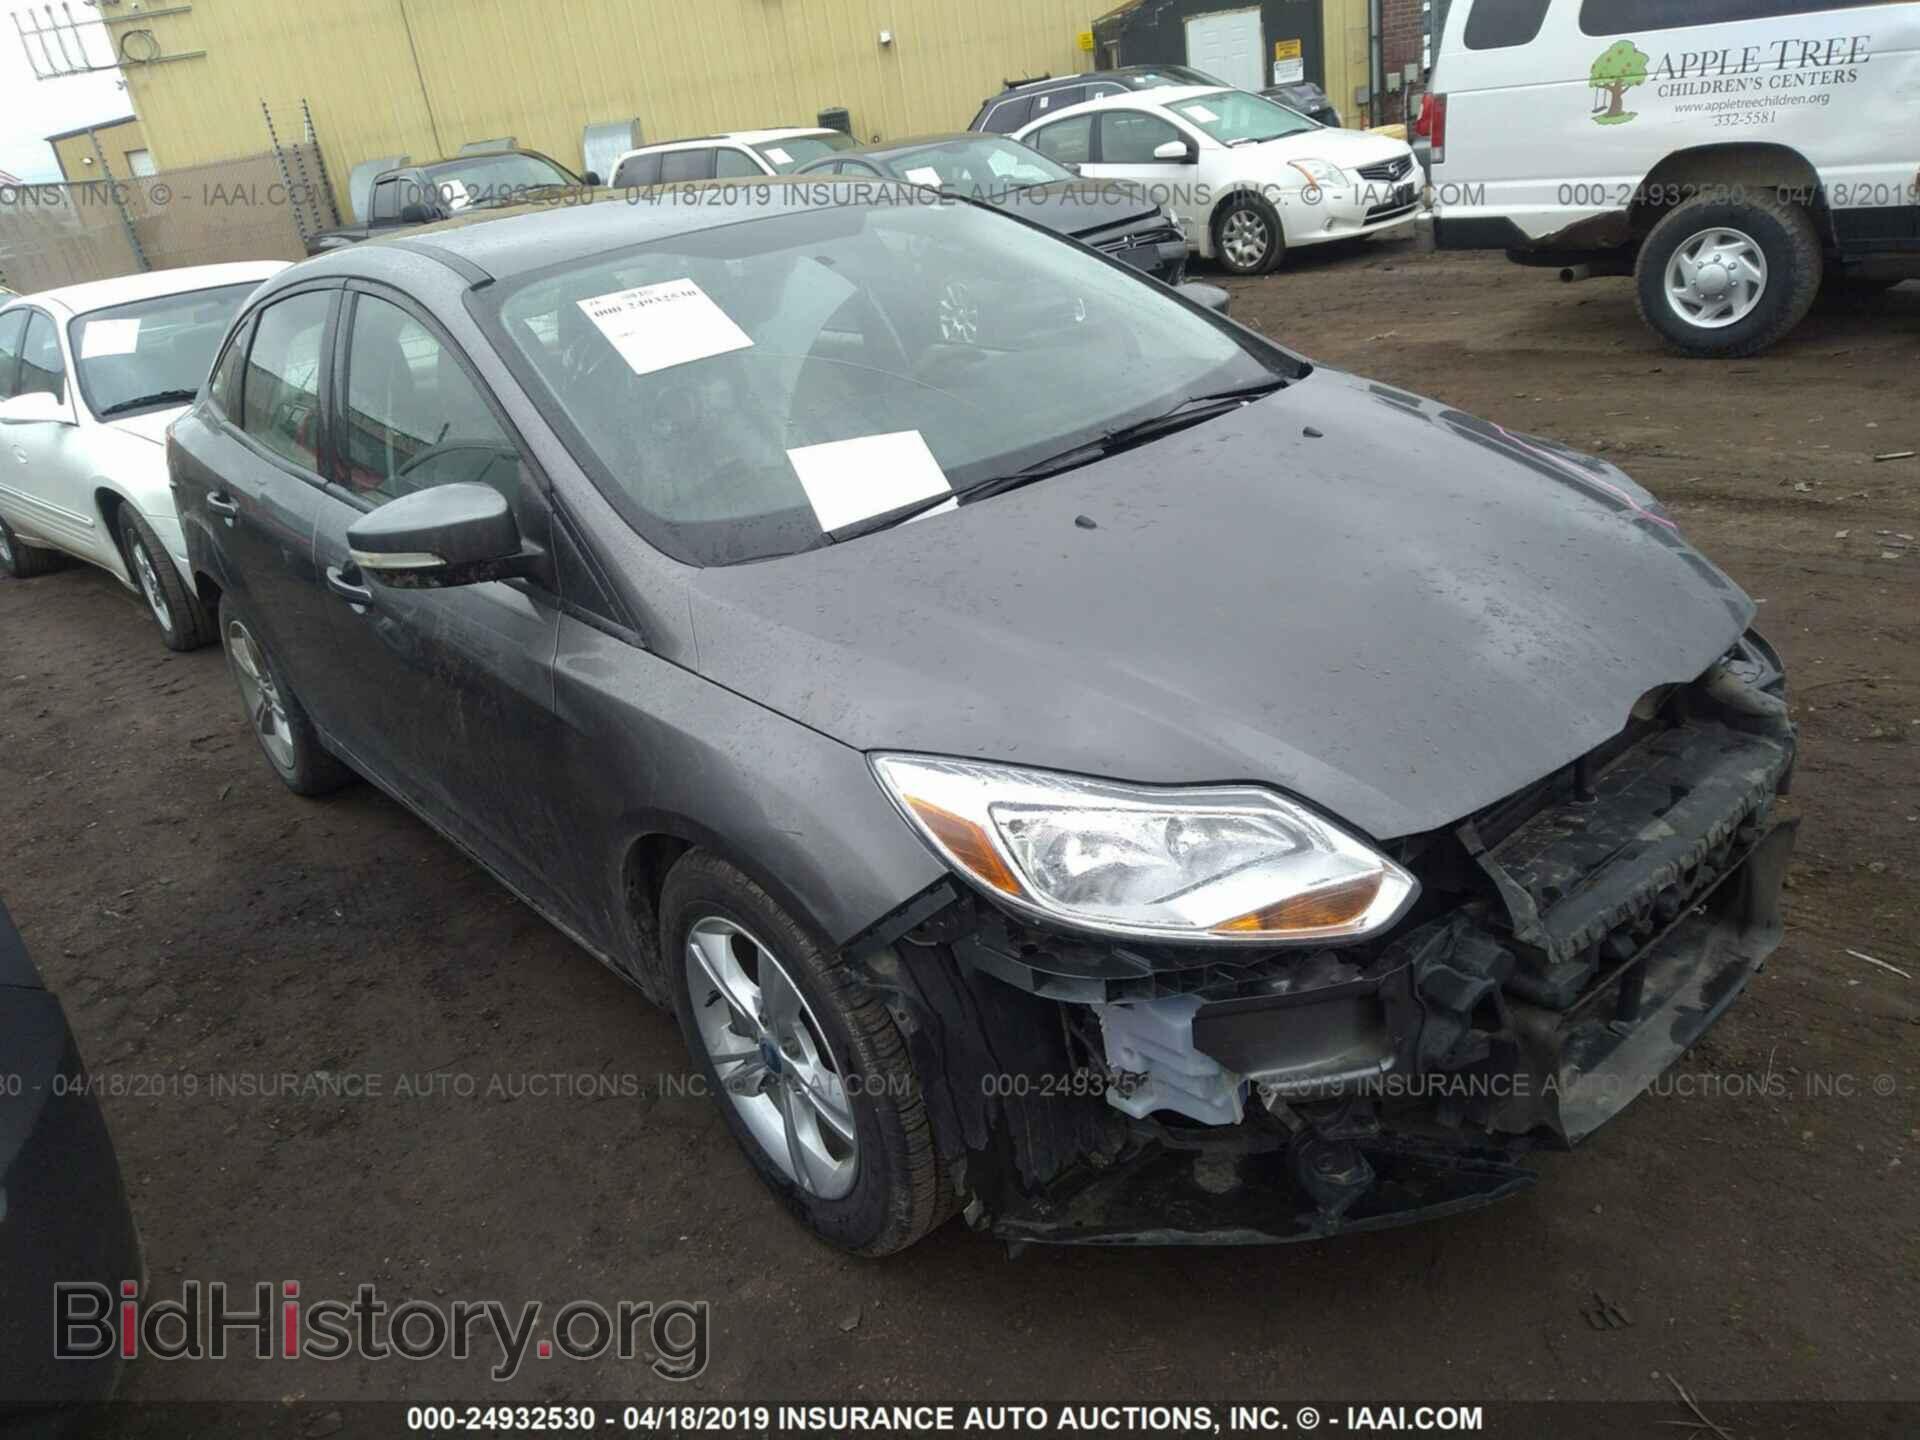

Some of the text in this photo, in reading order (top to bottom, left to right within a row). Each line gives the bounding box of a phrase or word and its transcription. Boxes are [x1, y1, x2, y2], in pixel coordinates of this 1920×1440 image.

[1652, 35, 1871, 80] APPLE TREE
[1657, 68, 1858, 98] CHILDREN'S CENTERS
[1674, 92, 1831, 114] www.appletreechildren.org
[1713, 110, 1776, 127] 332-5581
